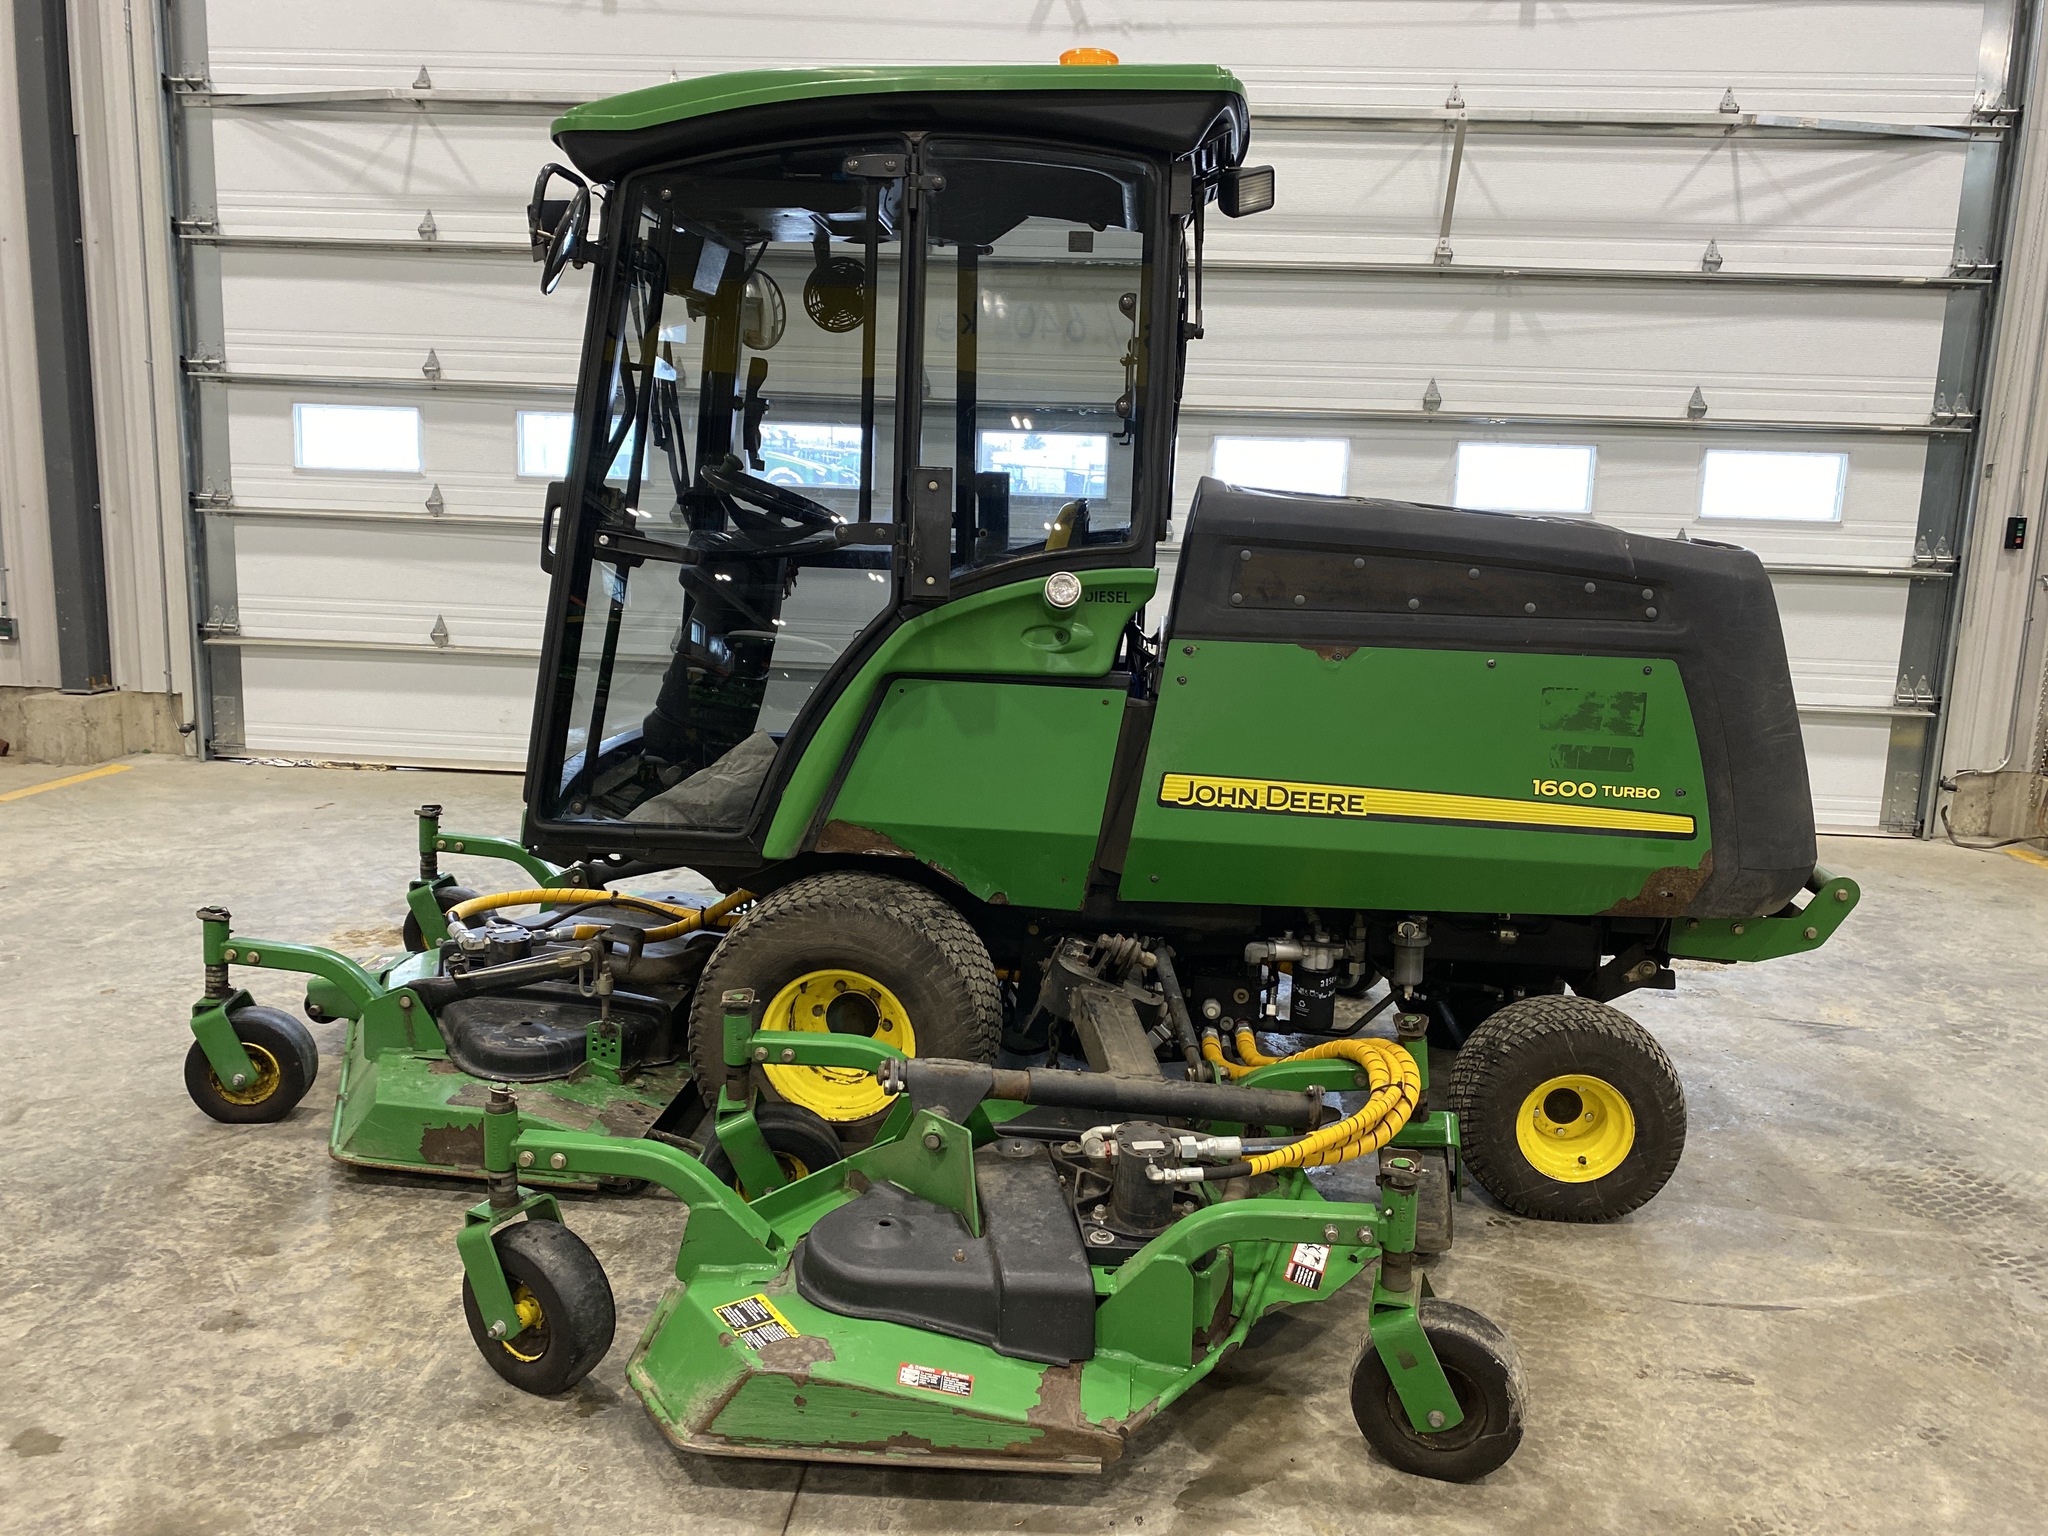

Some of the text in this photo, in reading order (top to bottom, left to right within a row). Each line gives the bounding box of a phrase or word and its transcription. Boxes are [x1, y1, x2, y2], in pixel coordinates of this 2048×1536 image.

[1085, 591, 1131, 603] DIESEL
[1177, 780, 1366, 814] JOHN DEERE
[1532, 779, 1661, 799] 1600 TURBO
